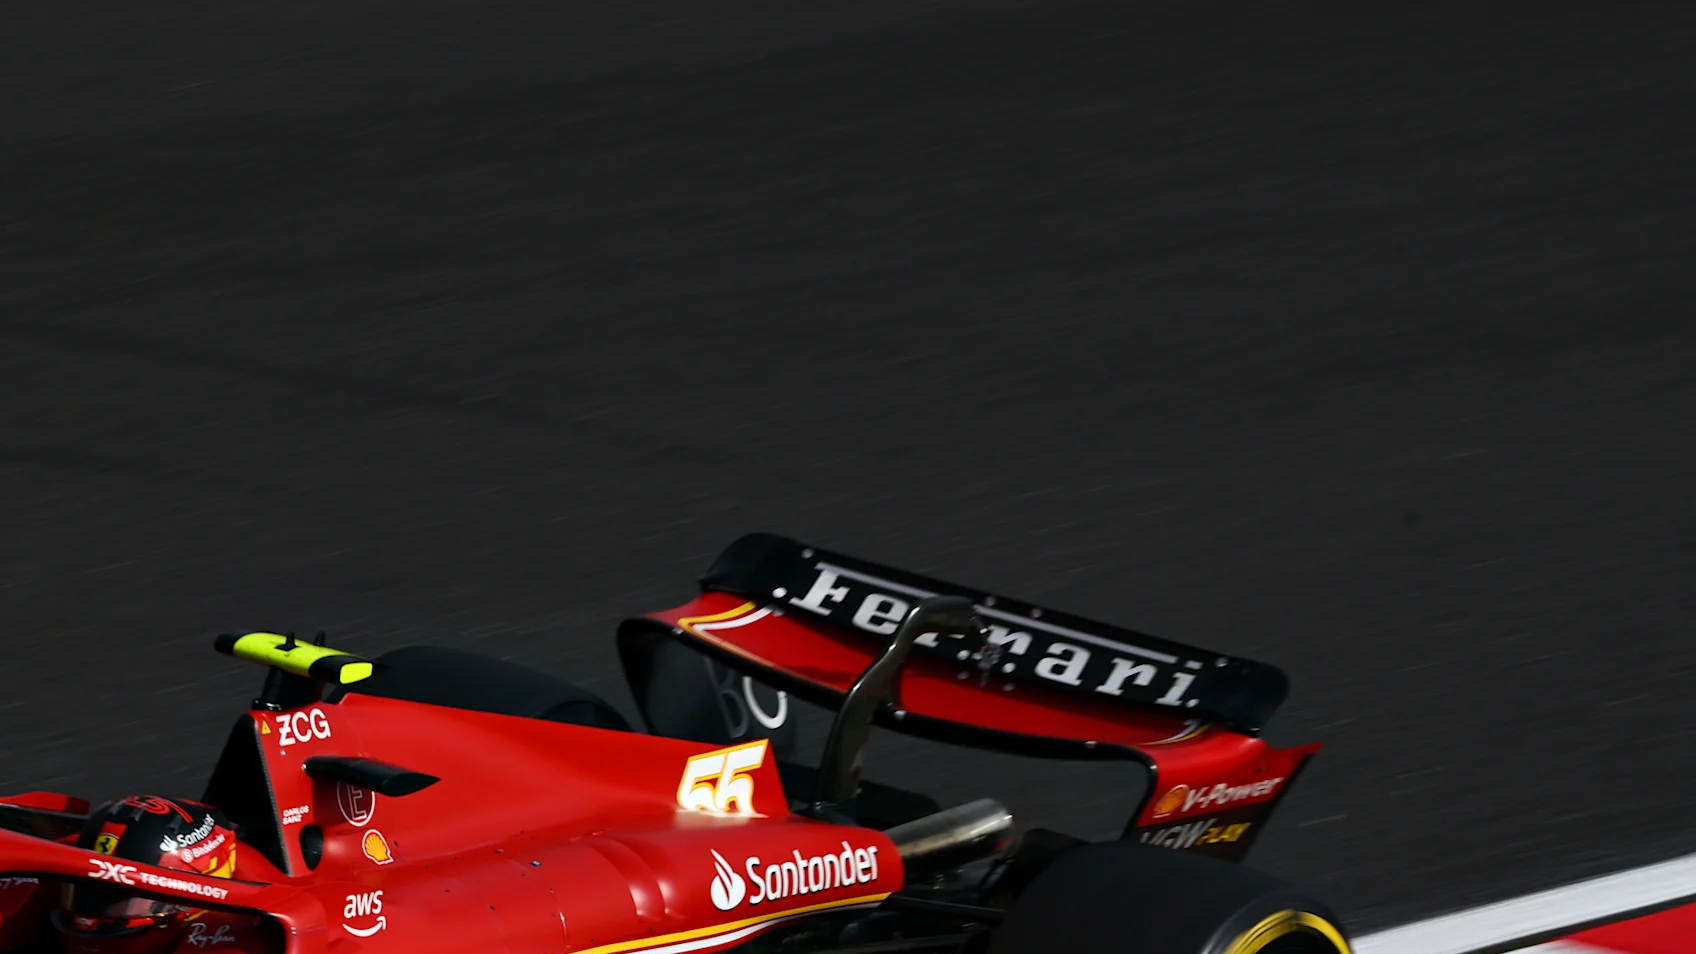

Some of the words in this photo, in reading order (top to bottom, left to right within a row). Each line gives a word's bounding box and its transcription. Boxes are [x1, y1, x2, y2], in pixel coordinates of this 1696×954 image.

[791, 563, 1203, 707] Ferari
[276, 708, 331, 746] ZCG
[677, 738, 770, 816] 55
[282, 814, 302, 825] SAINZ
[283, 805, 310, 817] CARLOS
[87, 858, 138, 885] DXC
[139, 872, 229, 900] TECHNOLOGY
[745, 841, 878, 905] Santander
[343, 890, 384, 918] aws
